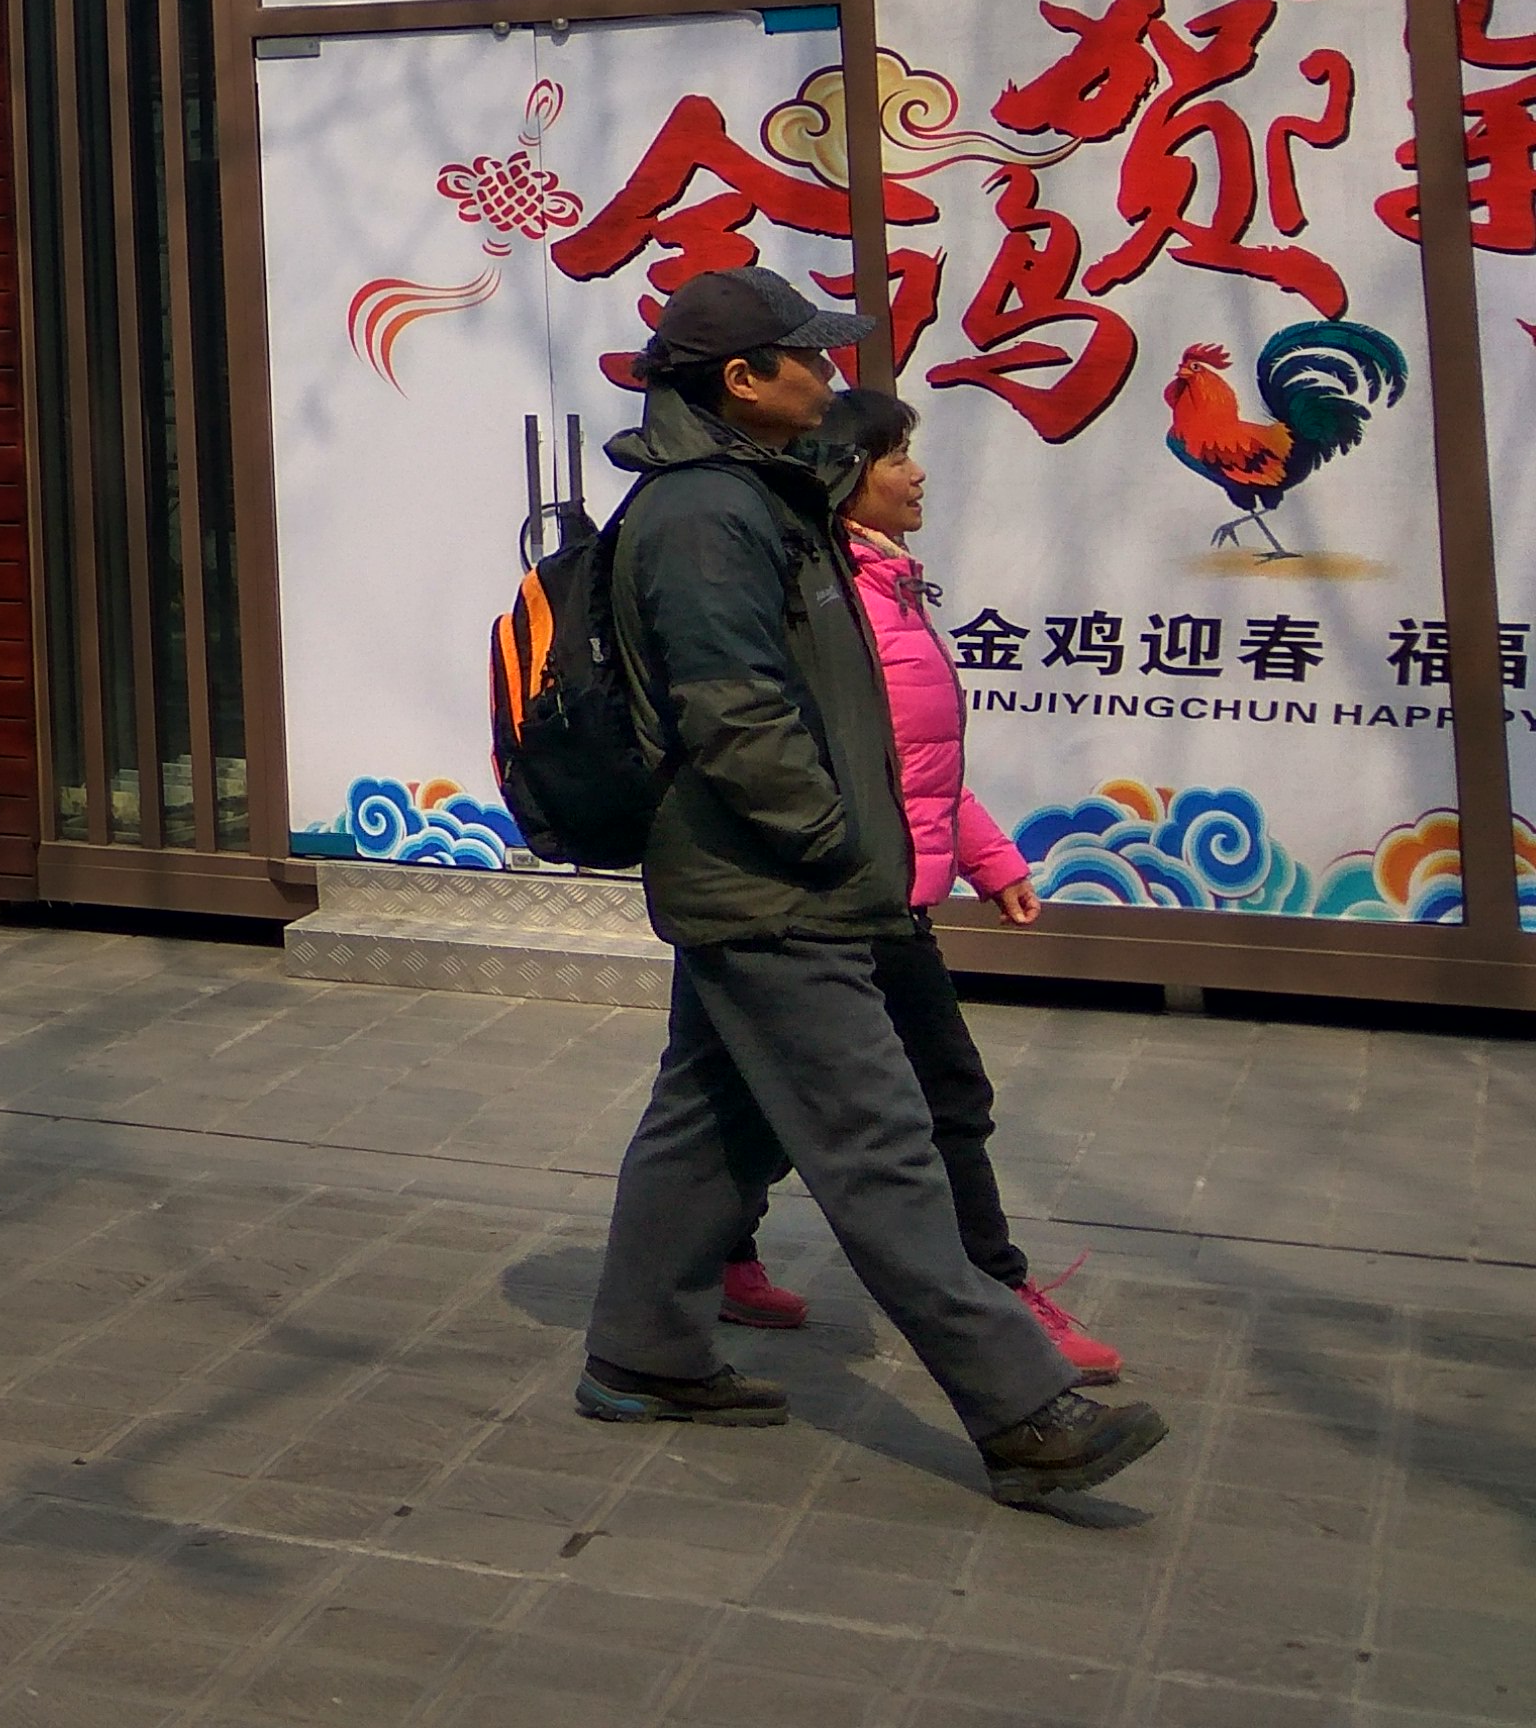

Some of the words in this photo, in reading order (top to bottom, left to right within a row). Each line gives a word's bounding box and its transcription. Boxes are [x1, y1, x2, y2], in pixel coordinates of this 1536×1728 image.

[948, 607, 1324, 684] 金鸡迎春
[963, 689, 1319, 725] INJIYINGCHUN
